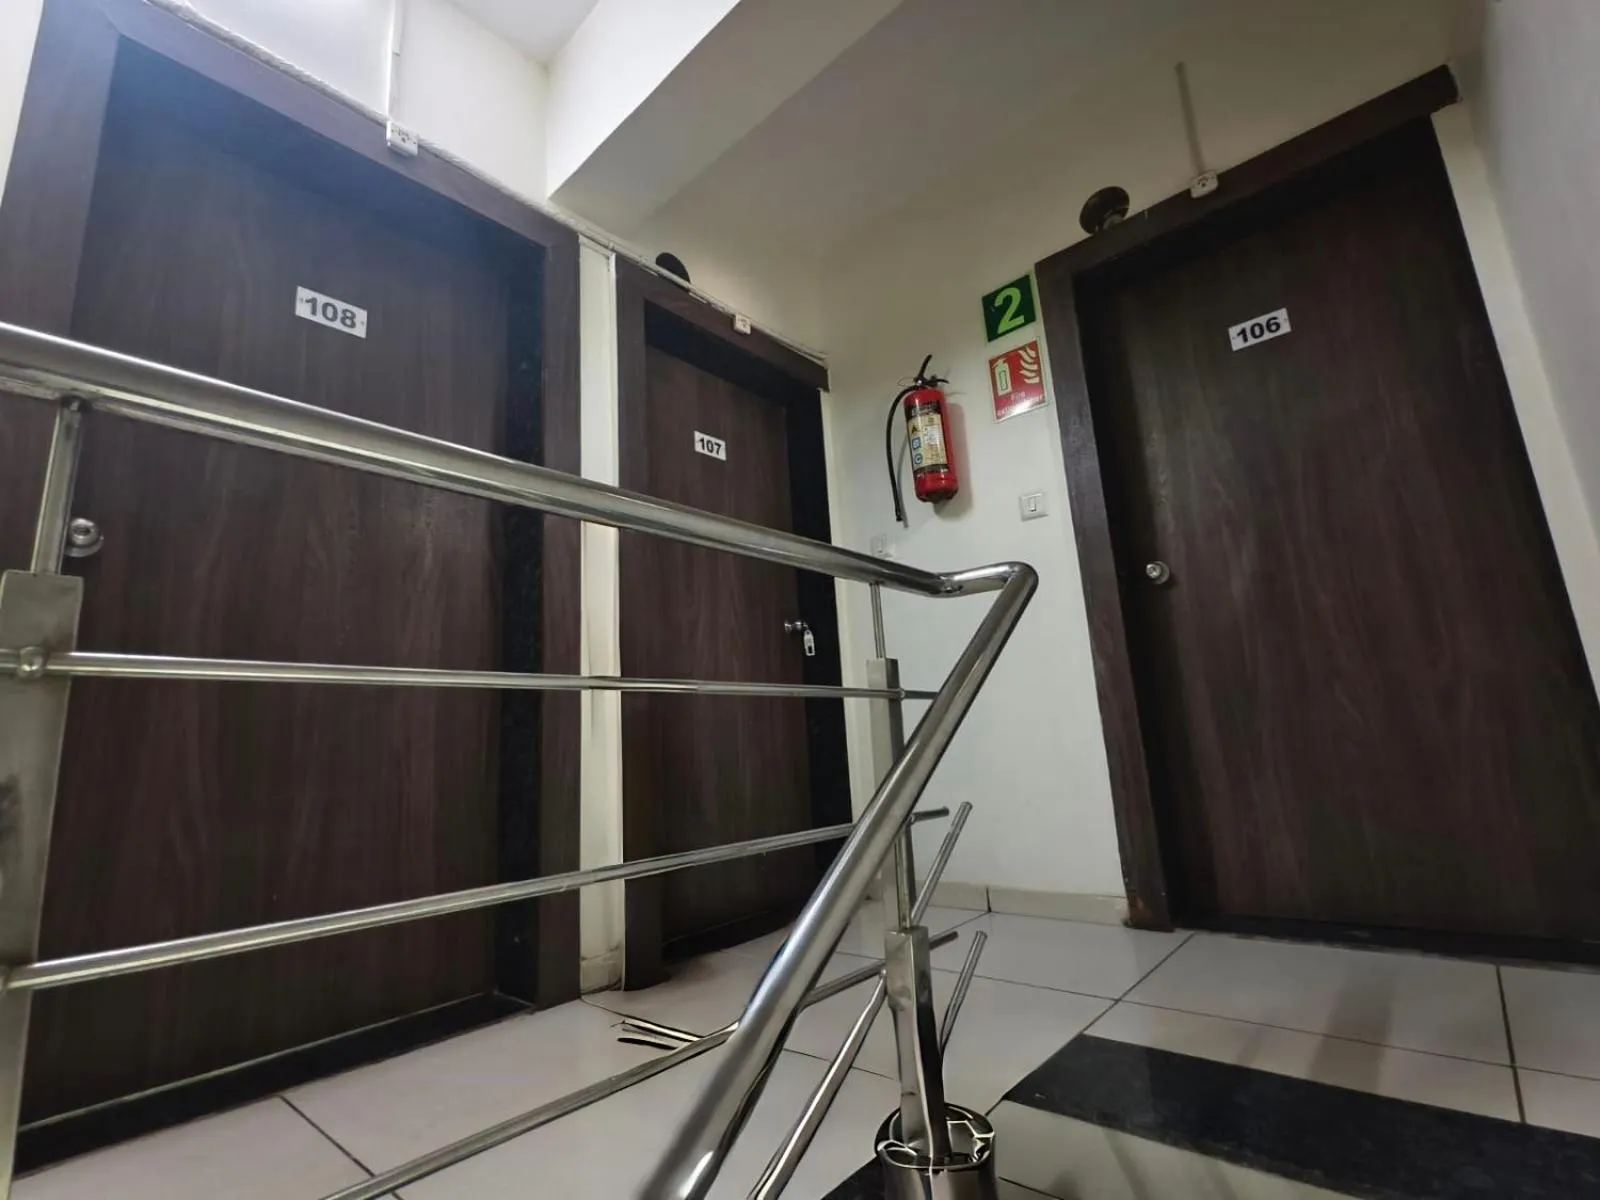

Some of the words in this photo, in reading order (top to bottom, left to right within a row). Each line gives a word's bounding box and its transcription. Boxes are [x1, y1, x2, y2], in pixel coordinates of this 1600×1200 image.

[305, 297, 356, 328] 108
[995, 287, 1024, 334] 2
[1237, 316, 1280, 343] 106
[700, 437, 721, 455] 107
